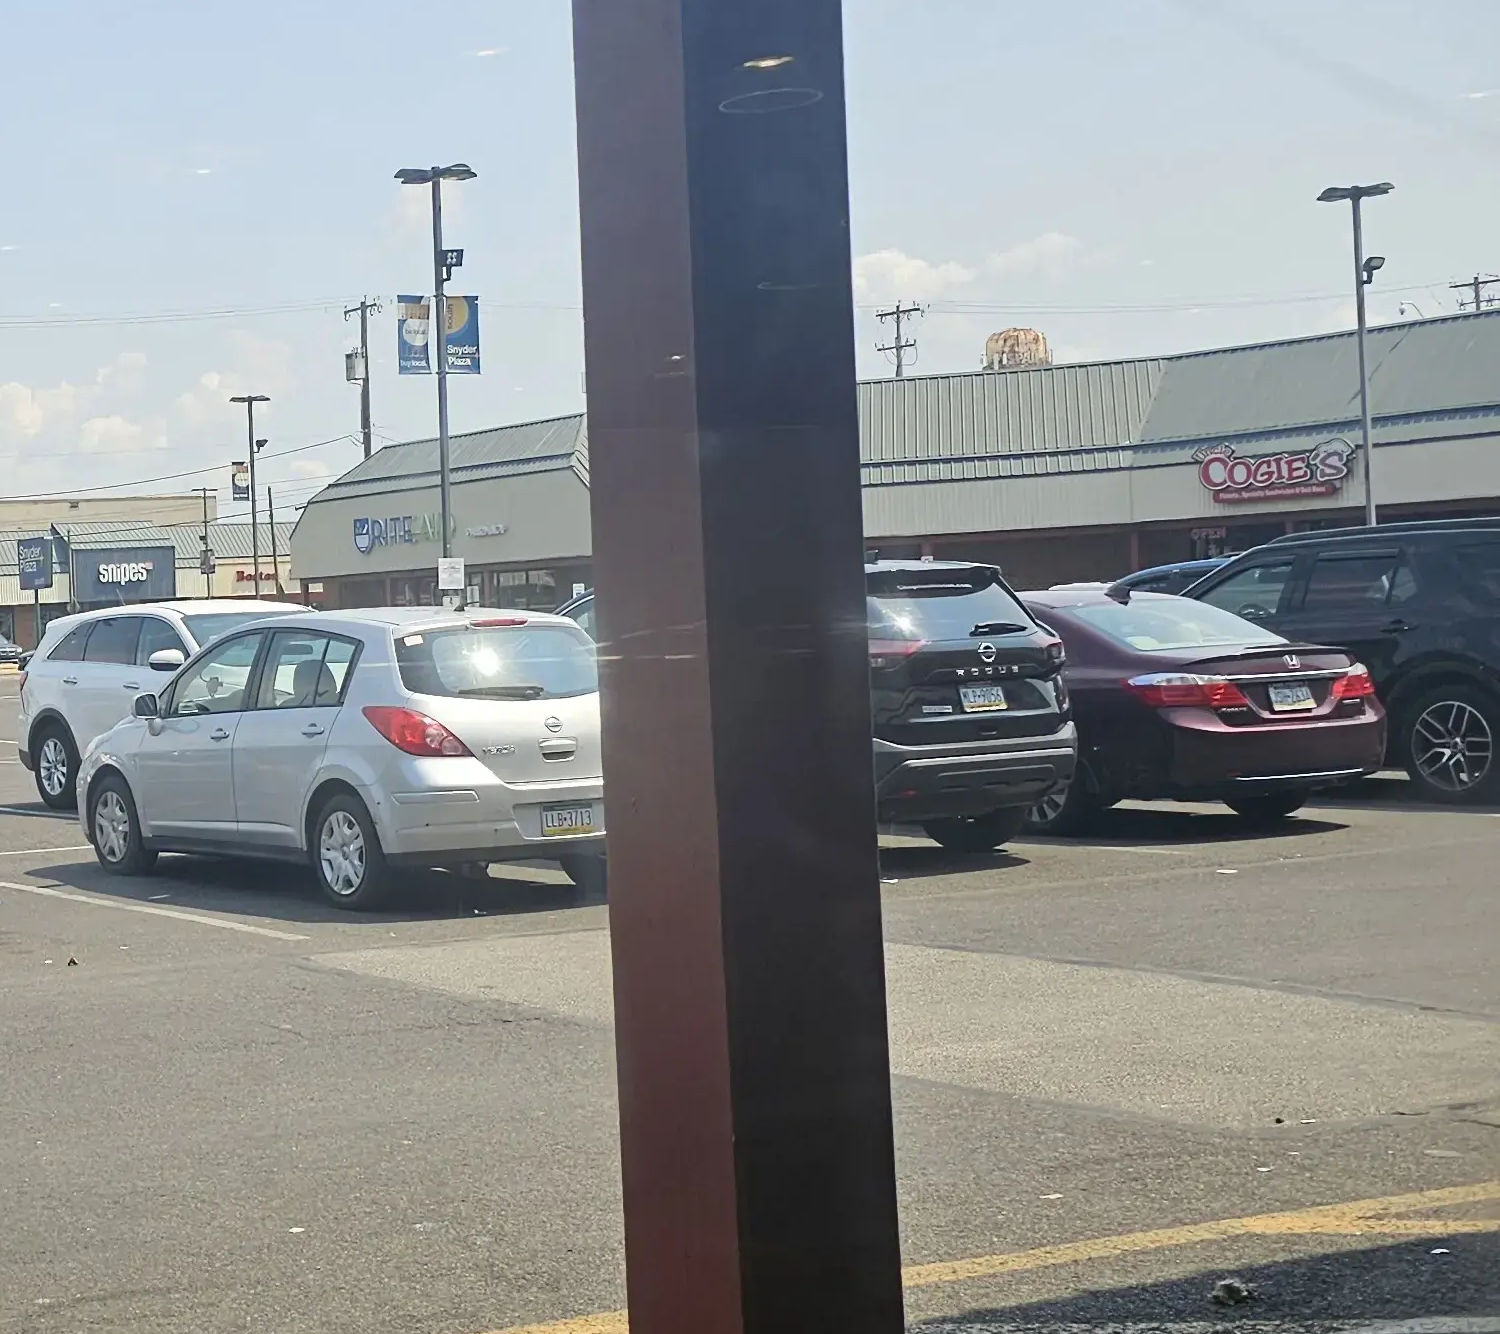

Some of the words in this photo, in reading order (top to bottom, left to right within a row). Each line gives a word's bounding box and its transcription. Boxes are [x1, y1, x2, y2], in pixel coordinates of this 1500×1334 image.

[447, 345, 477, 355] Snyder
[448, 356, 471, 365] Plaza
[1200, 451, 1347, 489] OOGIE'S
[373, 516, 413, 545] RITE
[20, 545, 41, 559] Snyder
[20, 560, 37, 573] Plaza
[99, 562, 148, 585] snipes
